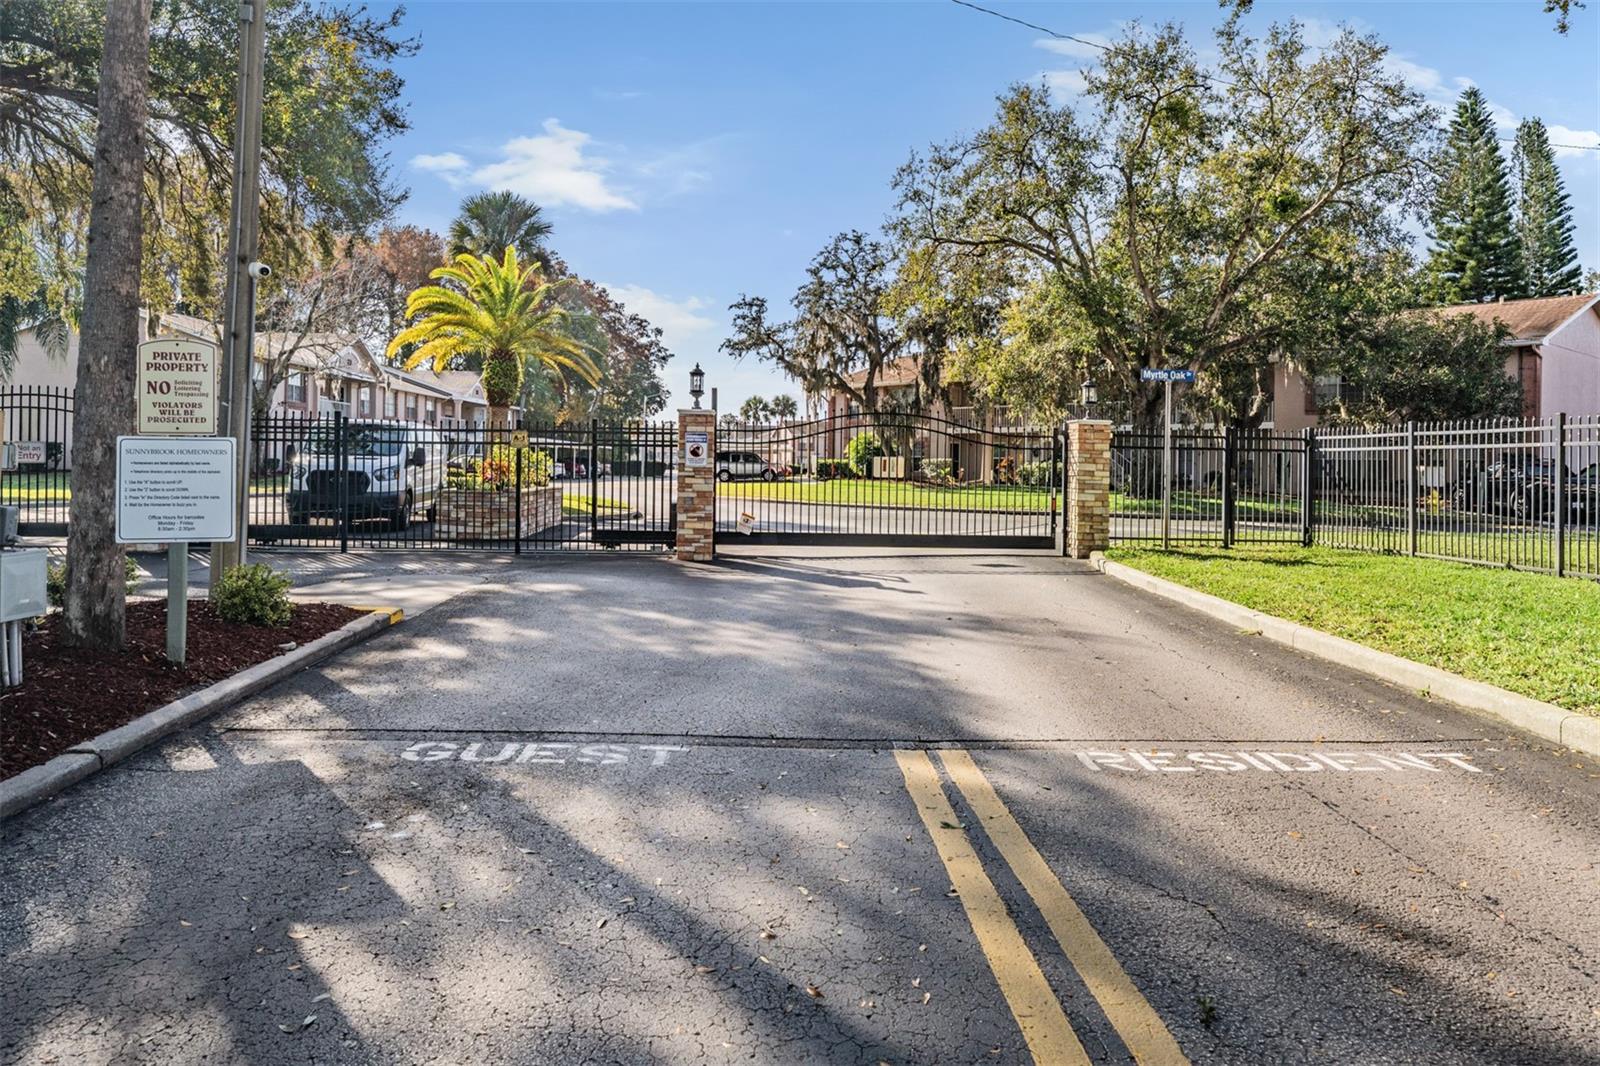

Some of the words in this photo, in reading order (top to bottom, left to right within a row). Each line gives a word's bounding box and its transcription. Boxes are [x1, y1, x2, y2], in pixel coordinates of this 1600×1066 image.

[152, 352, 202, 361] PRIVATE
[146, 362, 208, 372] PROPERTY
[1144, 370, 1168, 380] Myrtle
[1170, 370, 1186, 379] Oak
[146, 380, 171, 394] NO
[18, 451, 41, 460] Entry
[401, 742, 690, 764] GUEST
[1076, 752, 1483, 773] RESIDENT
